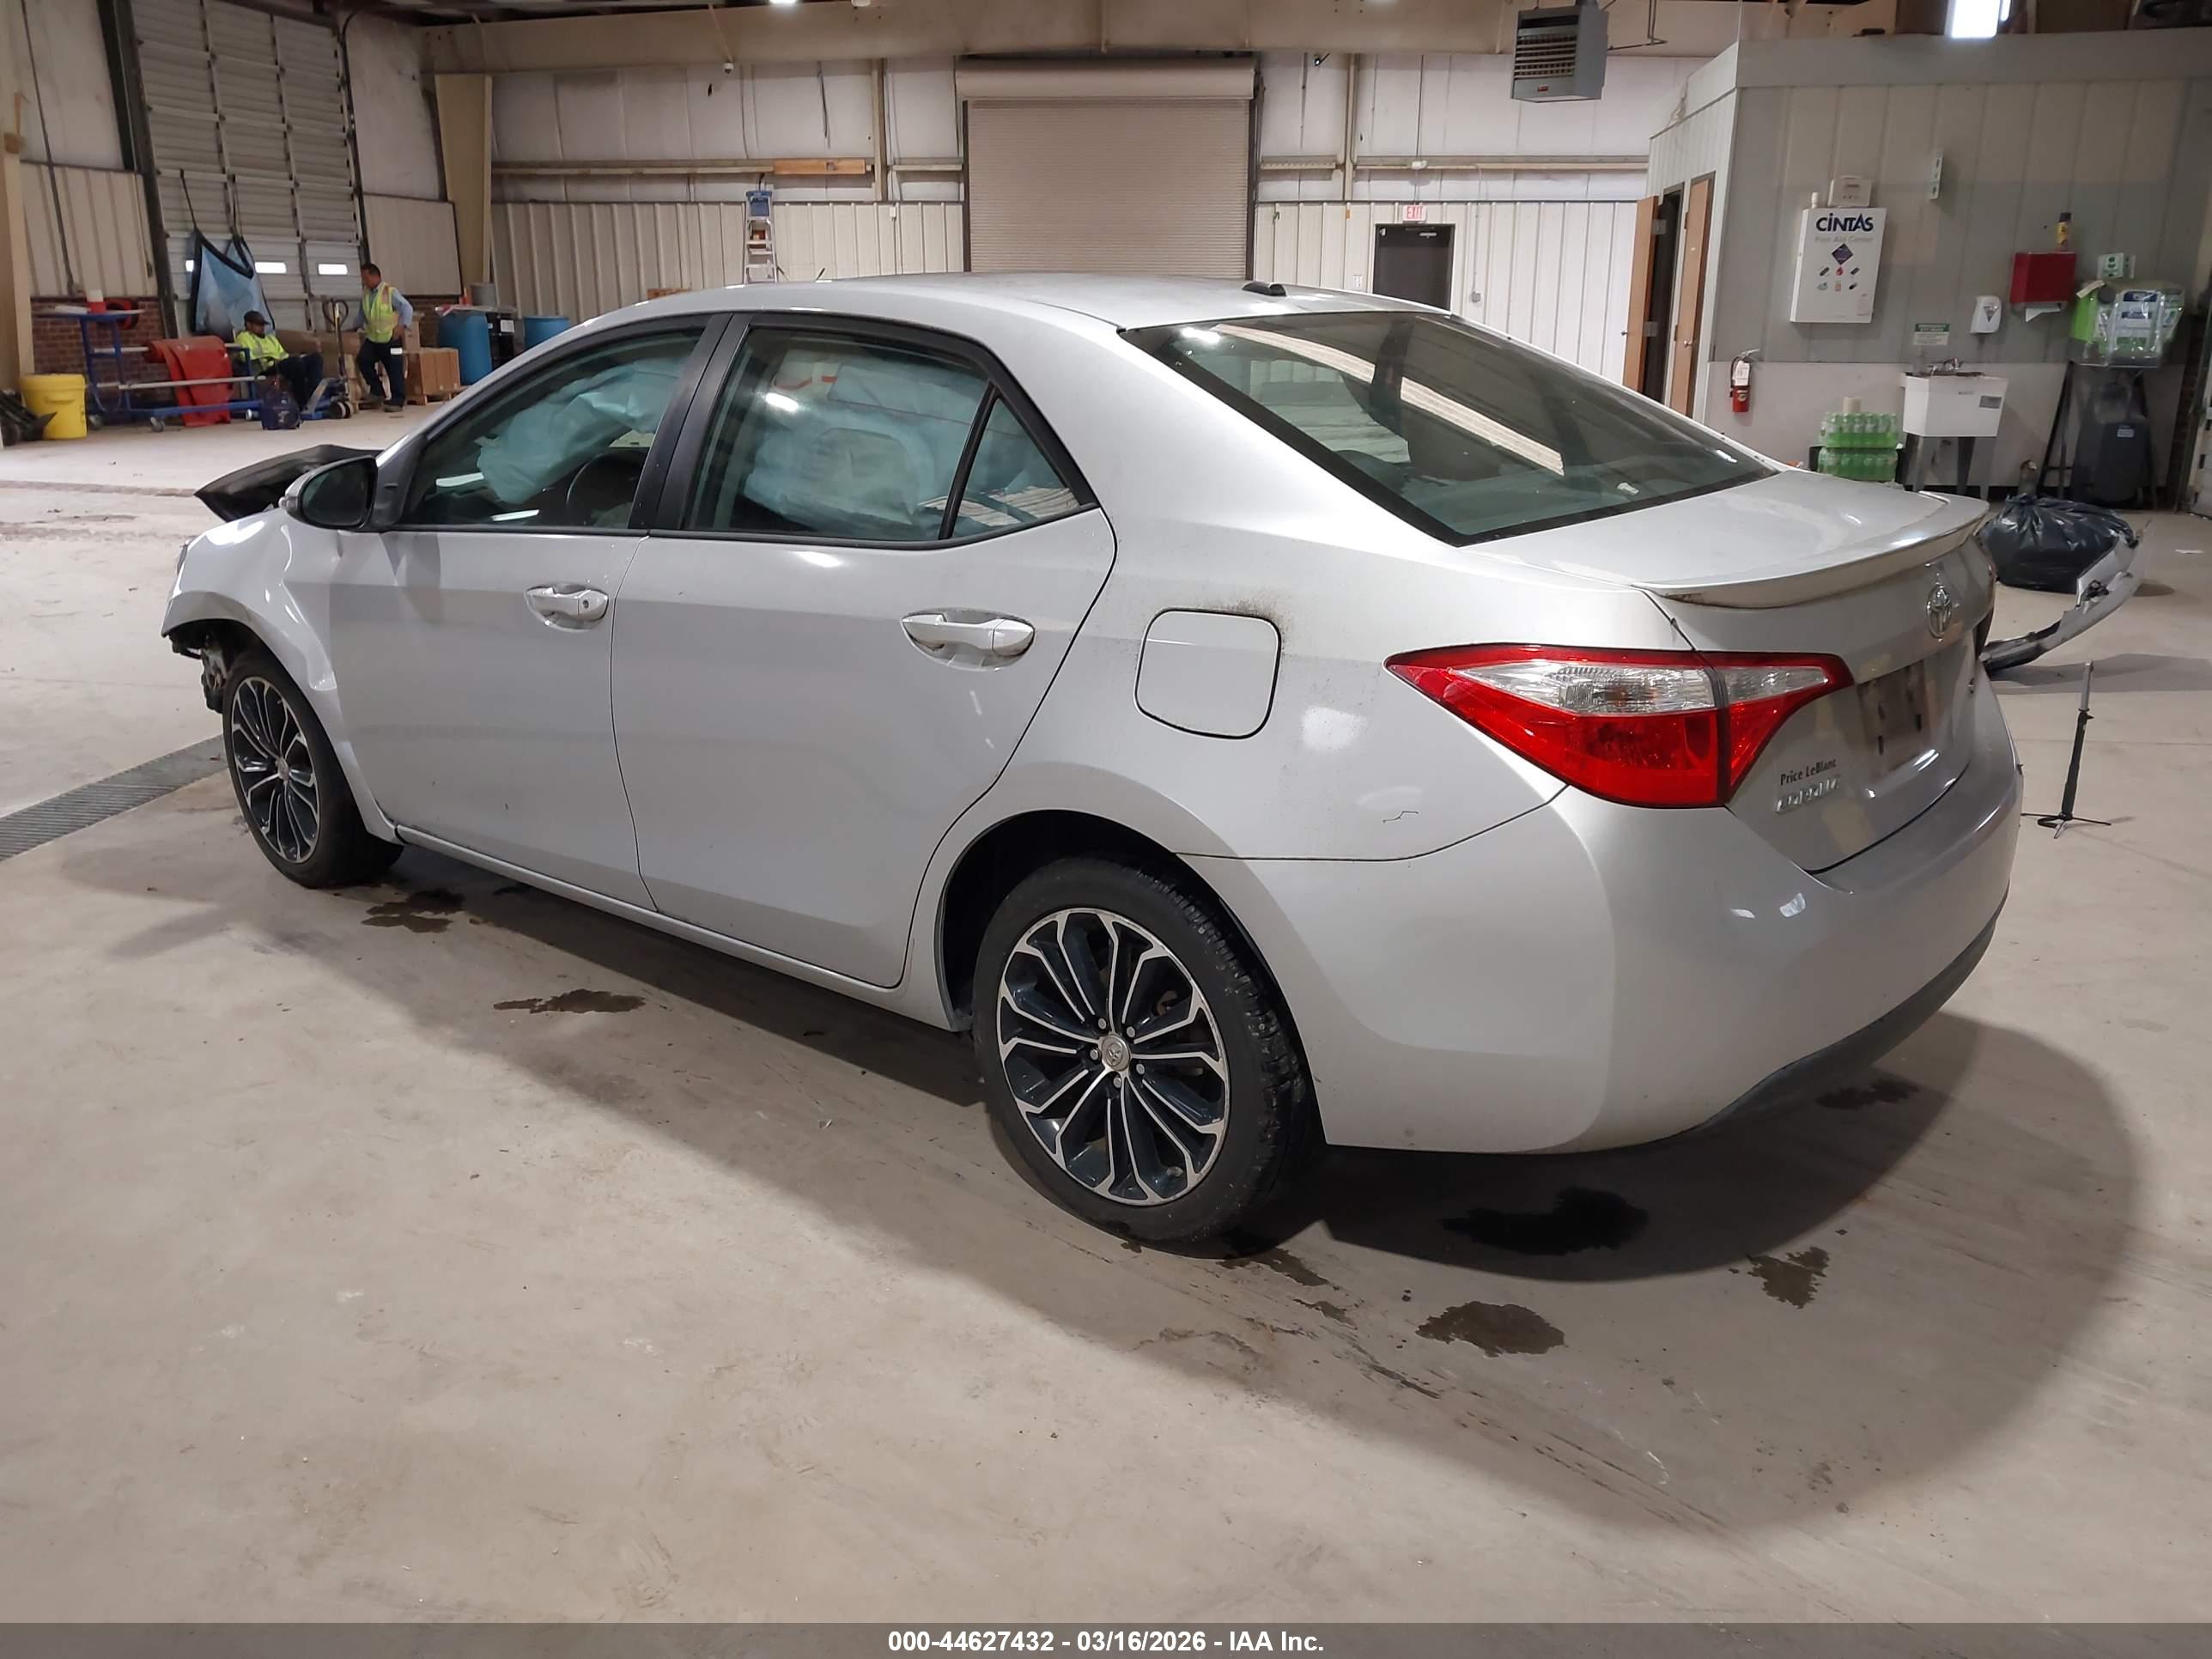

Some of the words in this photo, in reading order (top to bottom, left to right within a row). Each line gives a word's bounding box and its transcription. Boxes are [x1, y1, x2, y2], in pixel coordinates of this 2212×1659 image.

[1407, 206, 1423, 219] EXIT
[1780, 769, 1803, 786] Price
[1806, 758, 1836, 776] LeBlanc
